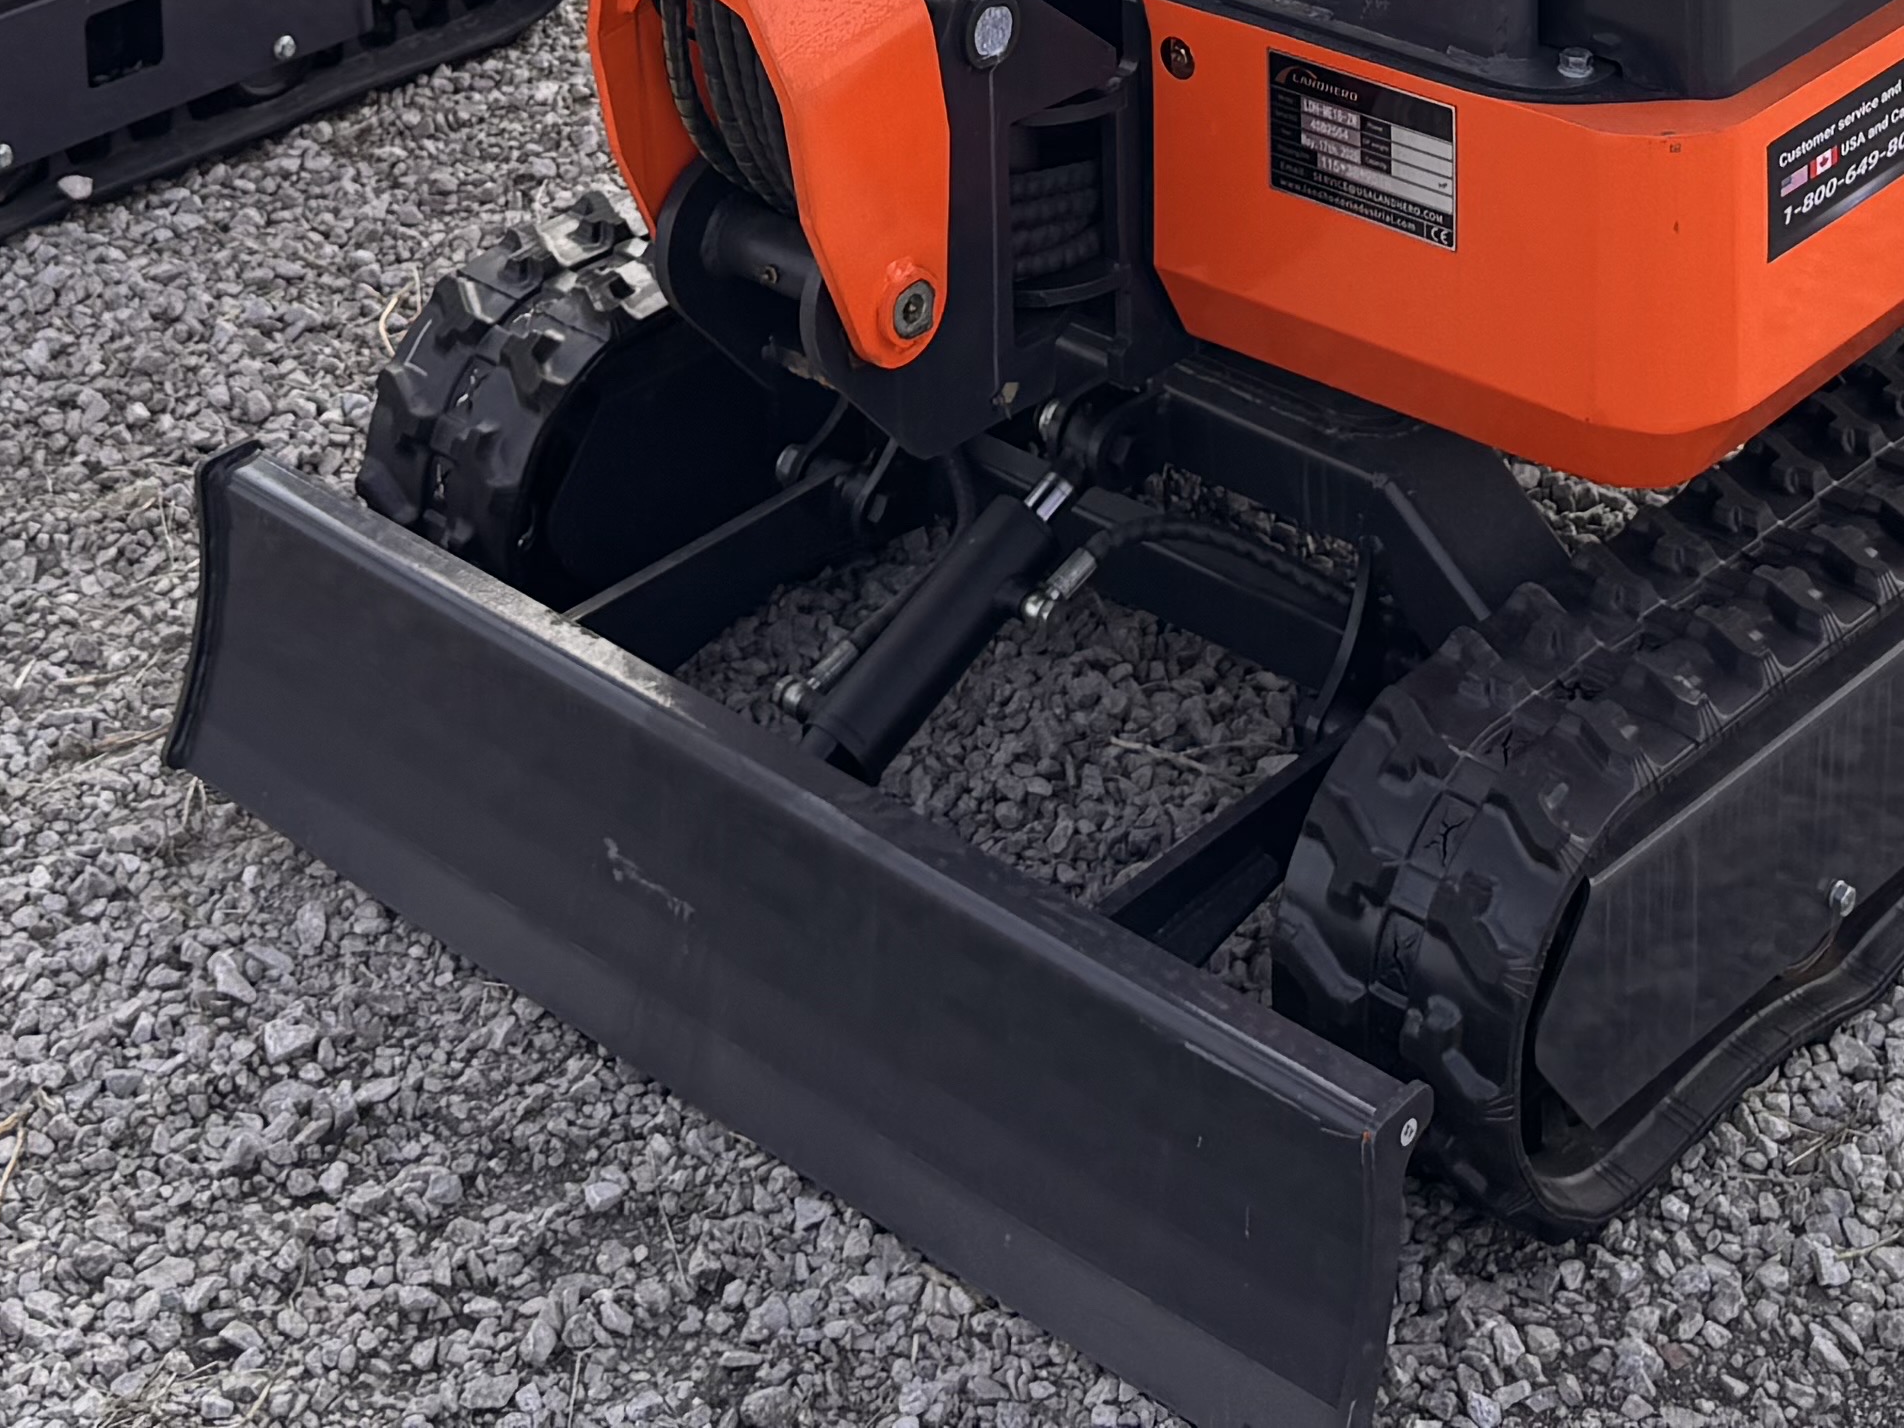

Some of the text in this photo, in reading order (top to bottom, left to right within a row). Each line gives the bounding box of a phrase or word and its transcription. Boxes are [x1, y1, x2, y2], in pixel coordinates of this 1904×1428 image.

[1292, 73, 1359, 102] LANDHERO
[1779, 123, 1836, 168] Customer
[1837, 97, 1880, 131] service
[1881, 78, 1903, 104] and
[1840, 131, 1866, 157] USA
[1867, 116, 1889, 140] and
[1430, 226, 1449, 245] CE
